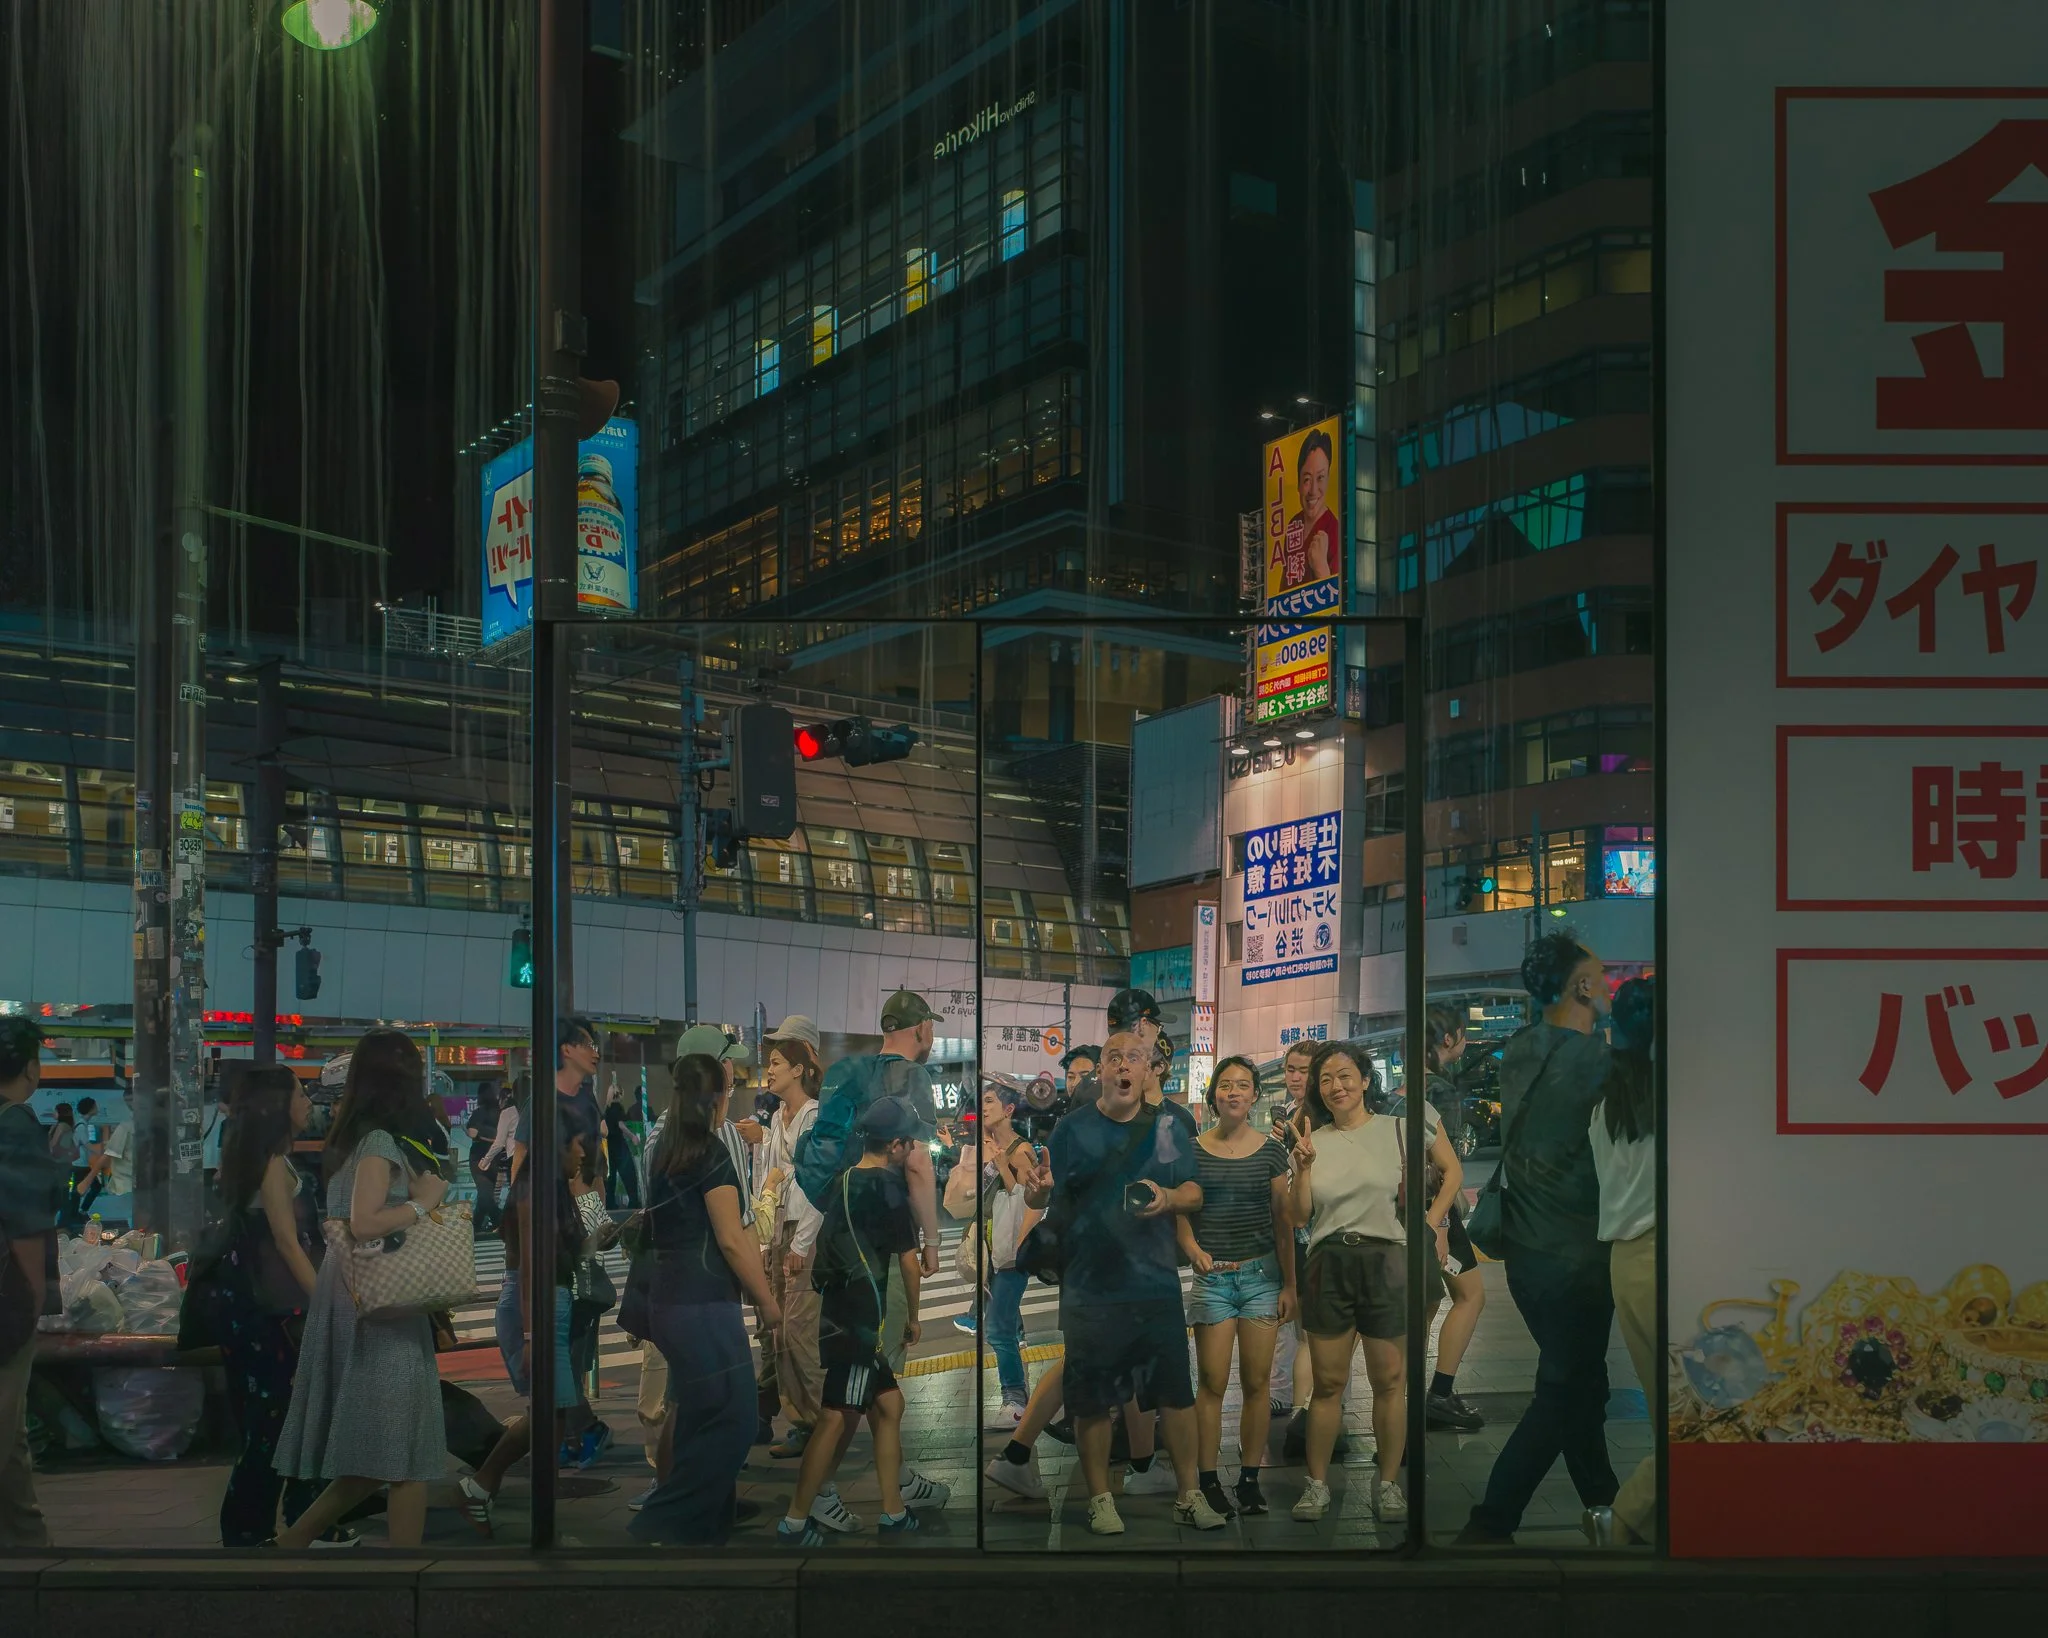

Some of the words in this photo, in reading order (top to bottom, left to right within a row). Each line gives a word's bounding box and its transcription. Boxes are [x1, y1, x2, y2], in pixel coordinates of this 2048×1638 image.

[1808, 539, 2038, 654] ダイヤ
[1911, 761, 2048, 879] 時
[1858, 984, 2048, 1100] バッ
